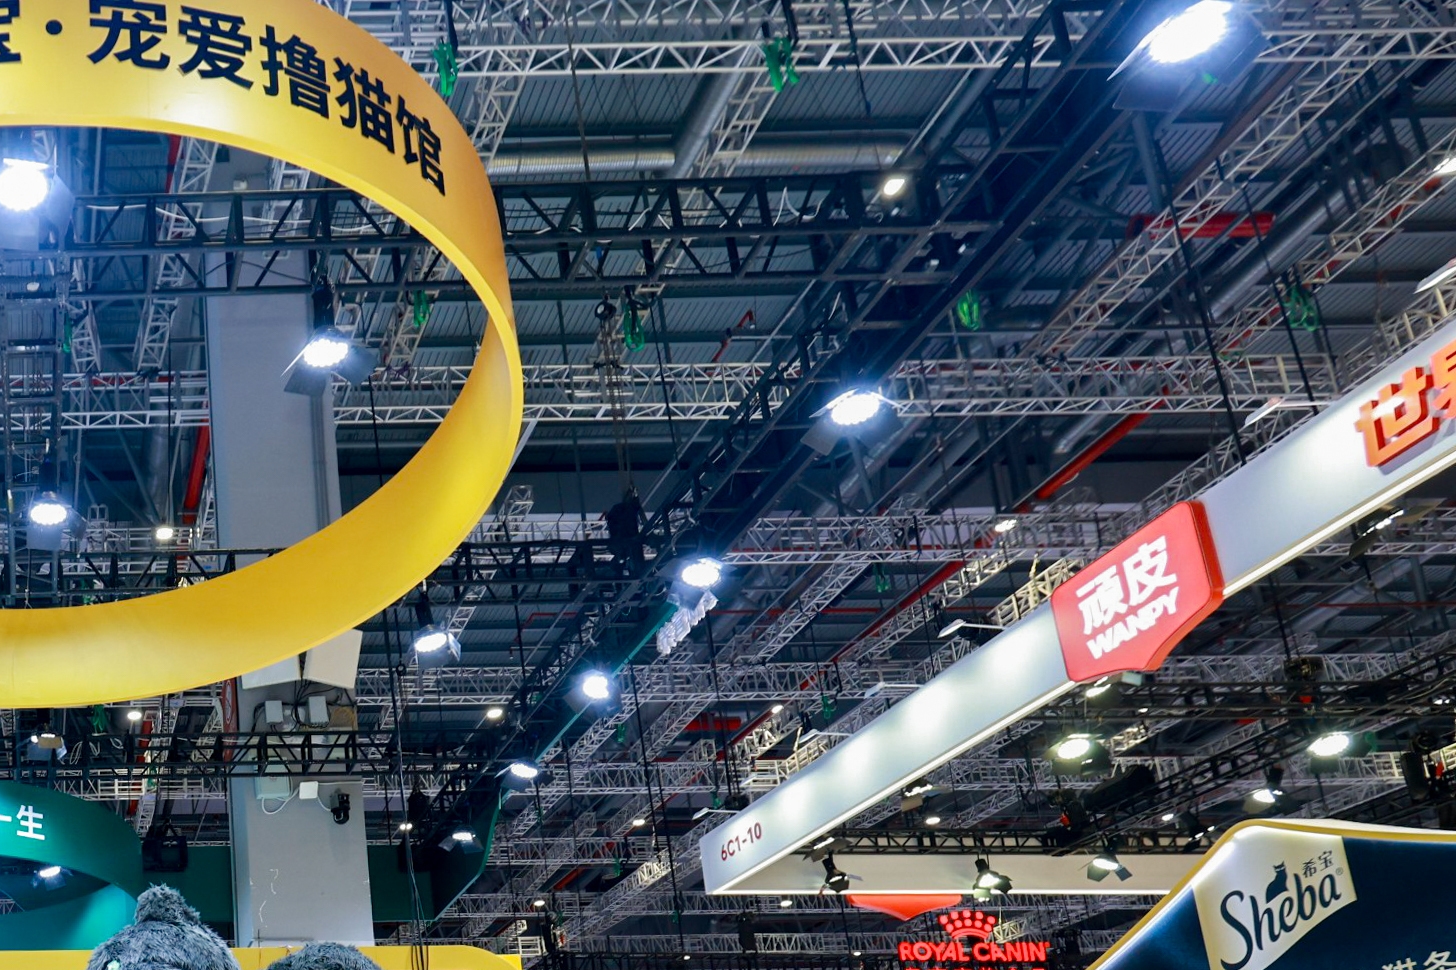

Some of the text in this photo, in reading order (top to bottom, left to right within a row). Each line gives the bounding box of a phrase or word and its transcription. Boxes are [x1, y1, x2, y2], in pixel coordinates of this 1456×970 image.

[1075, 535, 1178, 636] 顽皮
[1086, 587, 1180, 660] WANPY
[719, 822, 763, 863] 6C1-10
[1302, 850, 1333, 878] 希宝
[898, 941, 1047, 962] ROYAL CANIN
